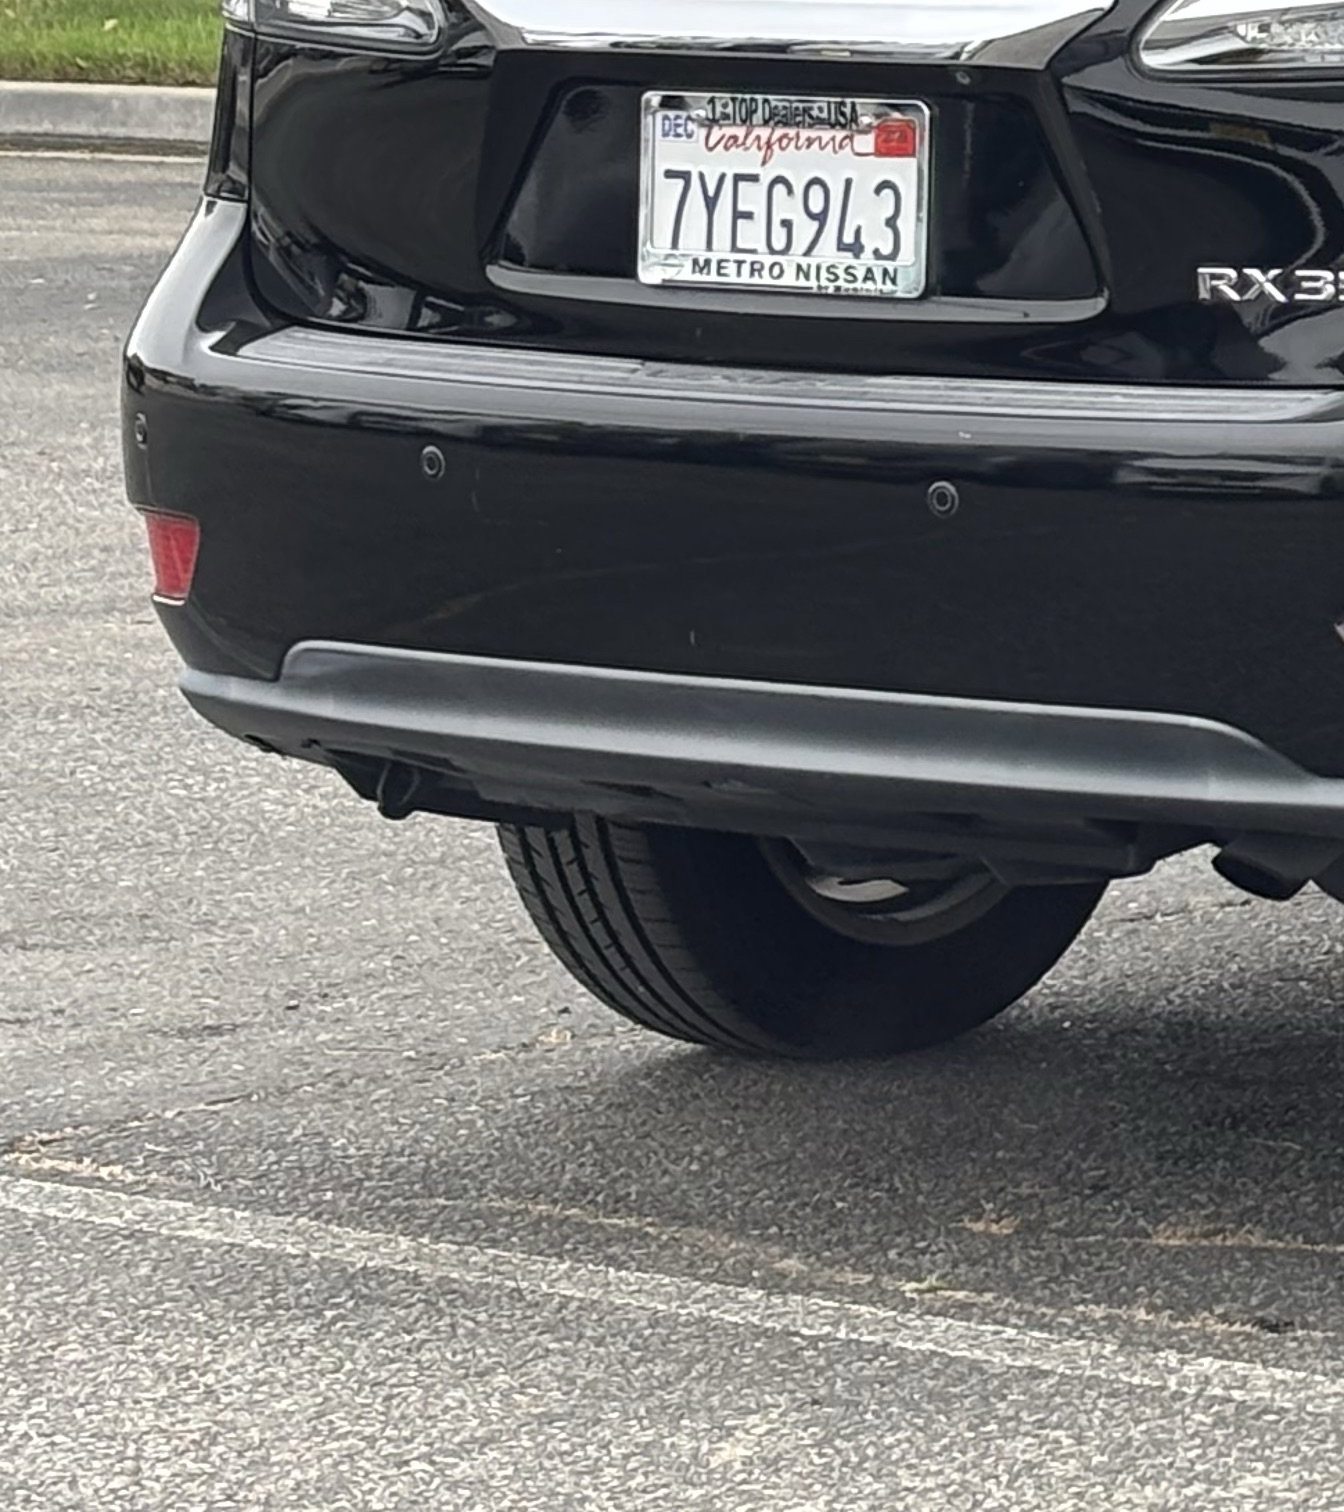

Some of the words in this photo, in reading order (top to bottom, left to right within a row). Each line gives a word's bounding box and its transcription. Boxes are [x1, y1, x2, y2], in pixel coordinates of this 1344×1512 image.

[661, 114, 695, 138] DEC
[703, 122, 855, 166] California
[663, 168, 902, 261] 7YEG943
[691, 257, 785, 281] METRO
[795, 262, 899, 286] NISSAN
